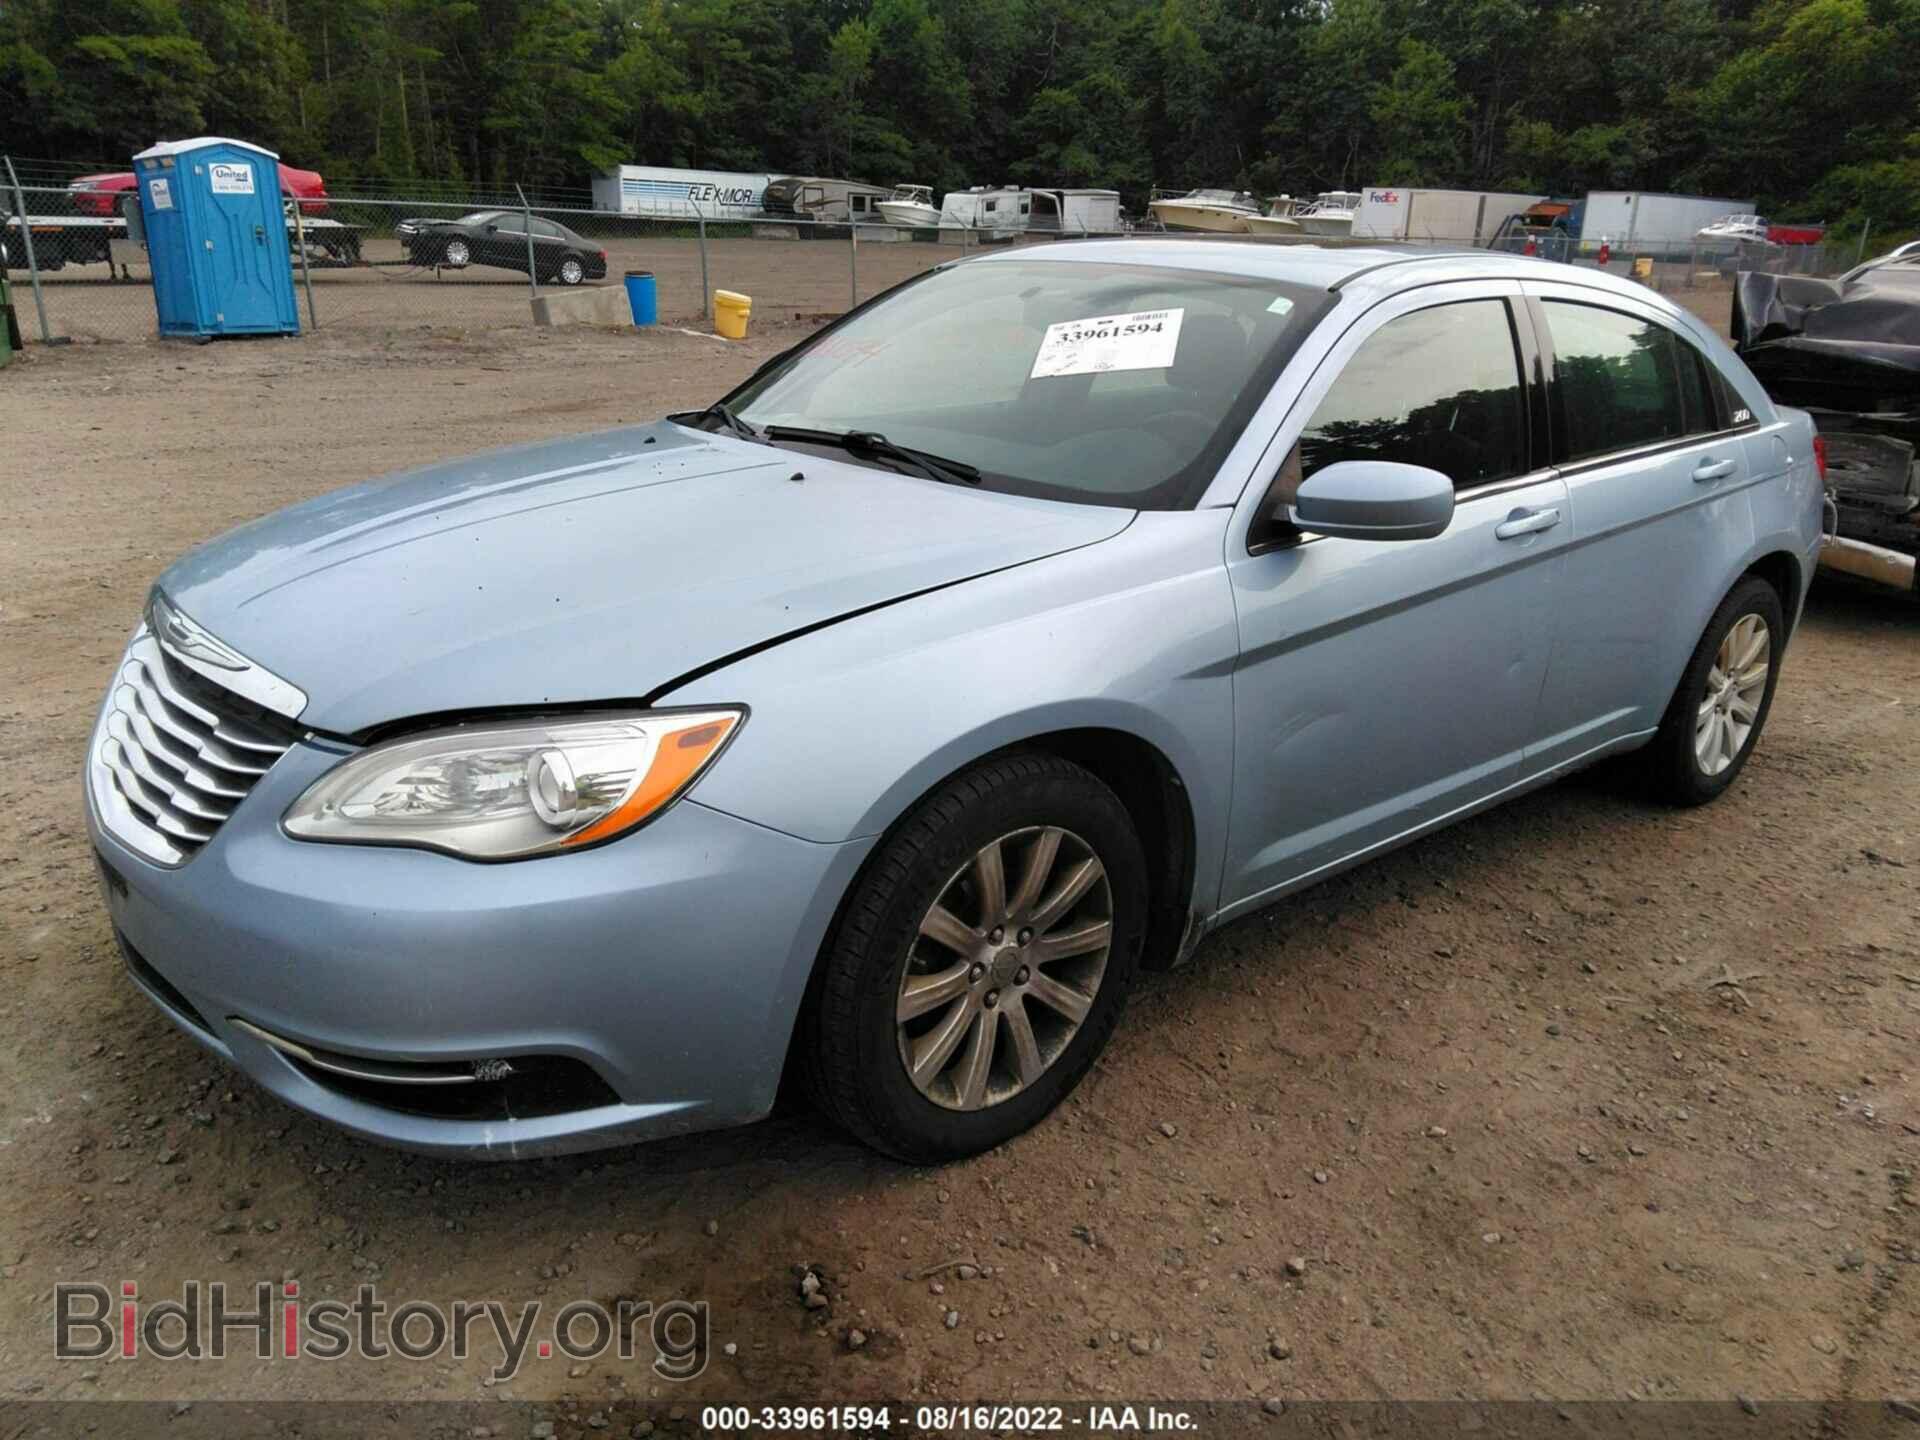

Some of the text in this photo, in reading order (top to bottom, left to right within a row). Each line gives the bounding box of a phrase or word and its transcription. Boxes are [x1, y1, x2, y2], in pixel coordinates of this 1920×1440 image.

[215, 169, 248, 178] United
[1370, 191, 1399, 204] FedEx
[1056, 322, 1164, 343] 33961594
